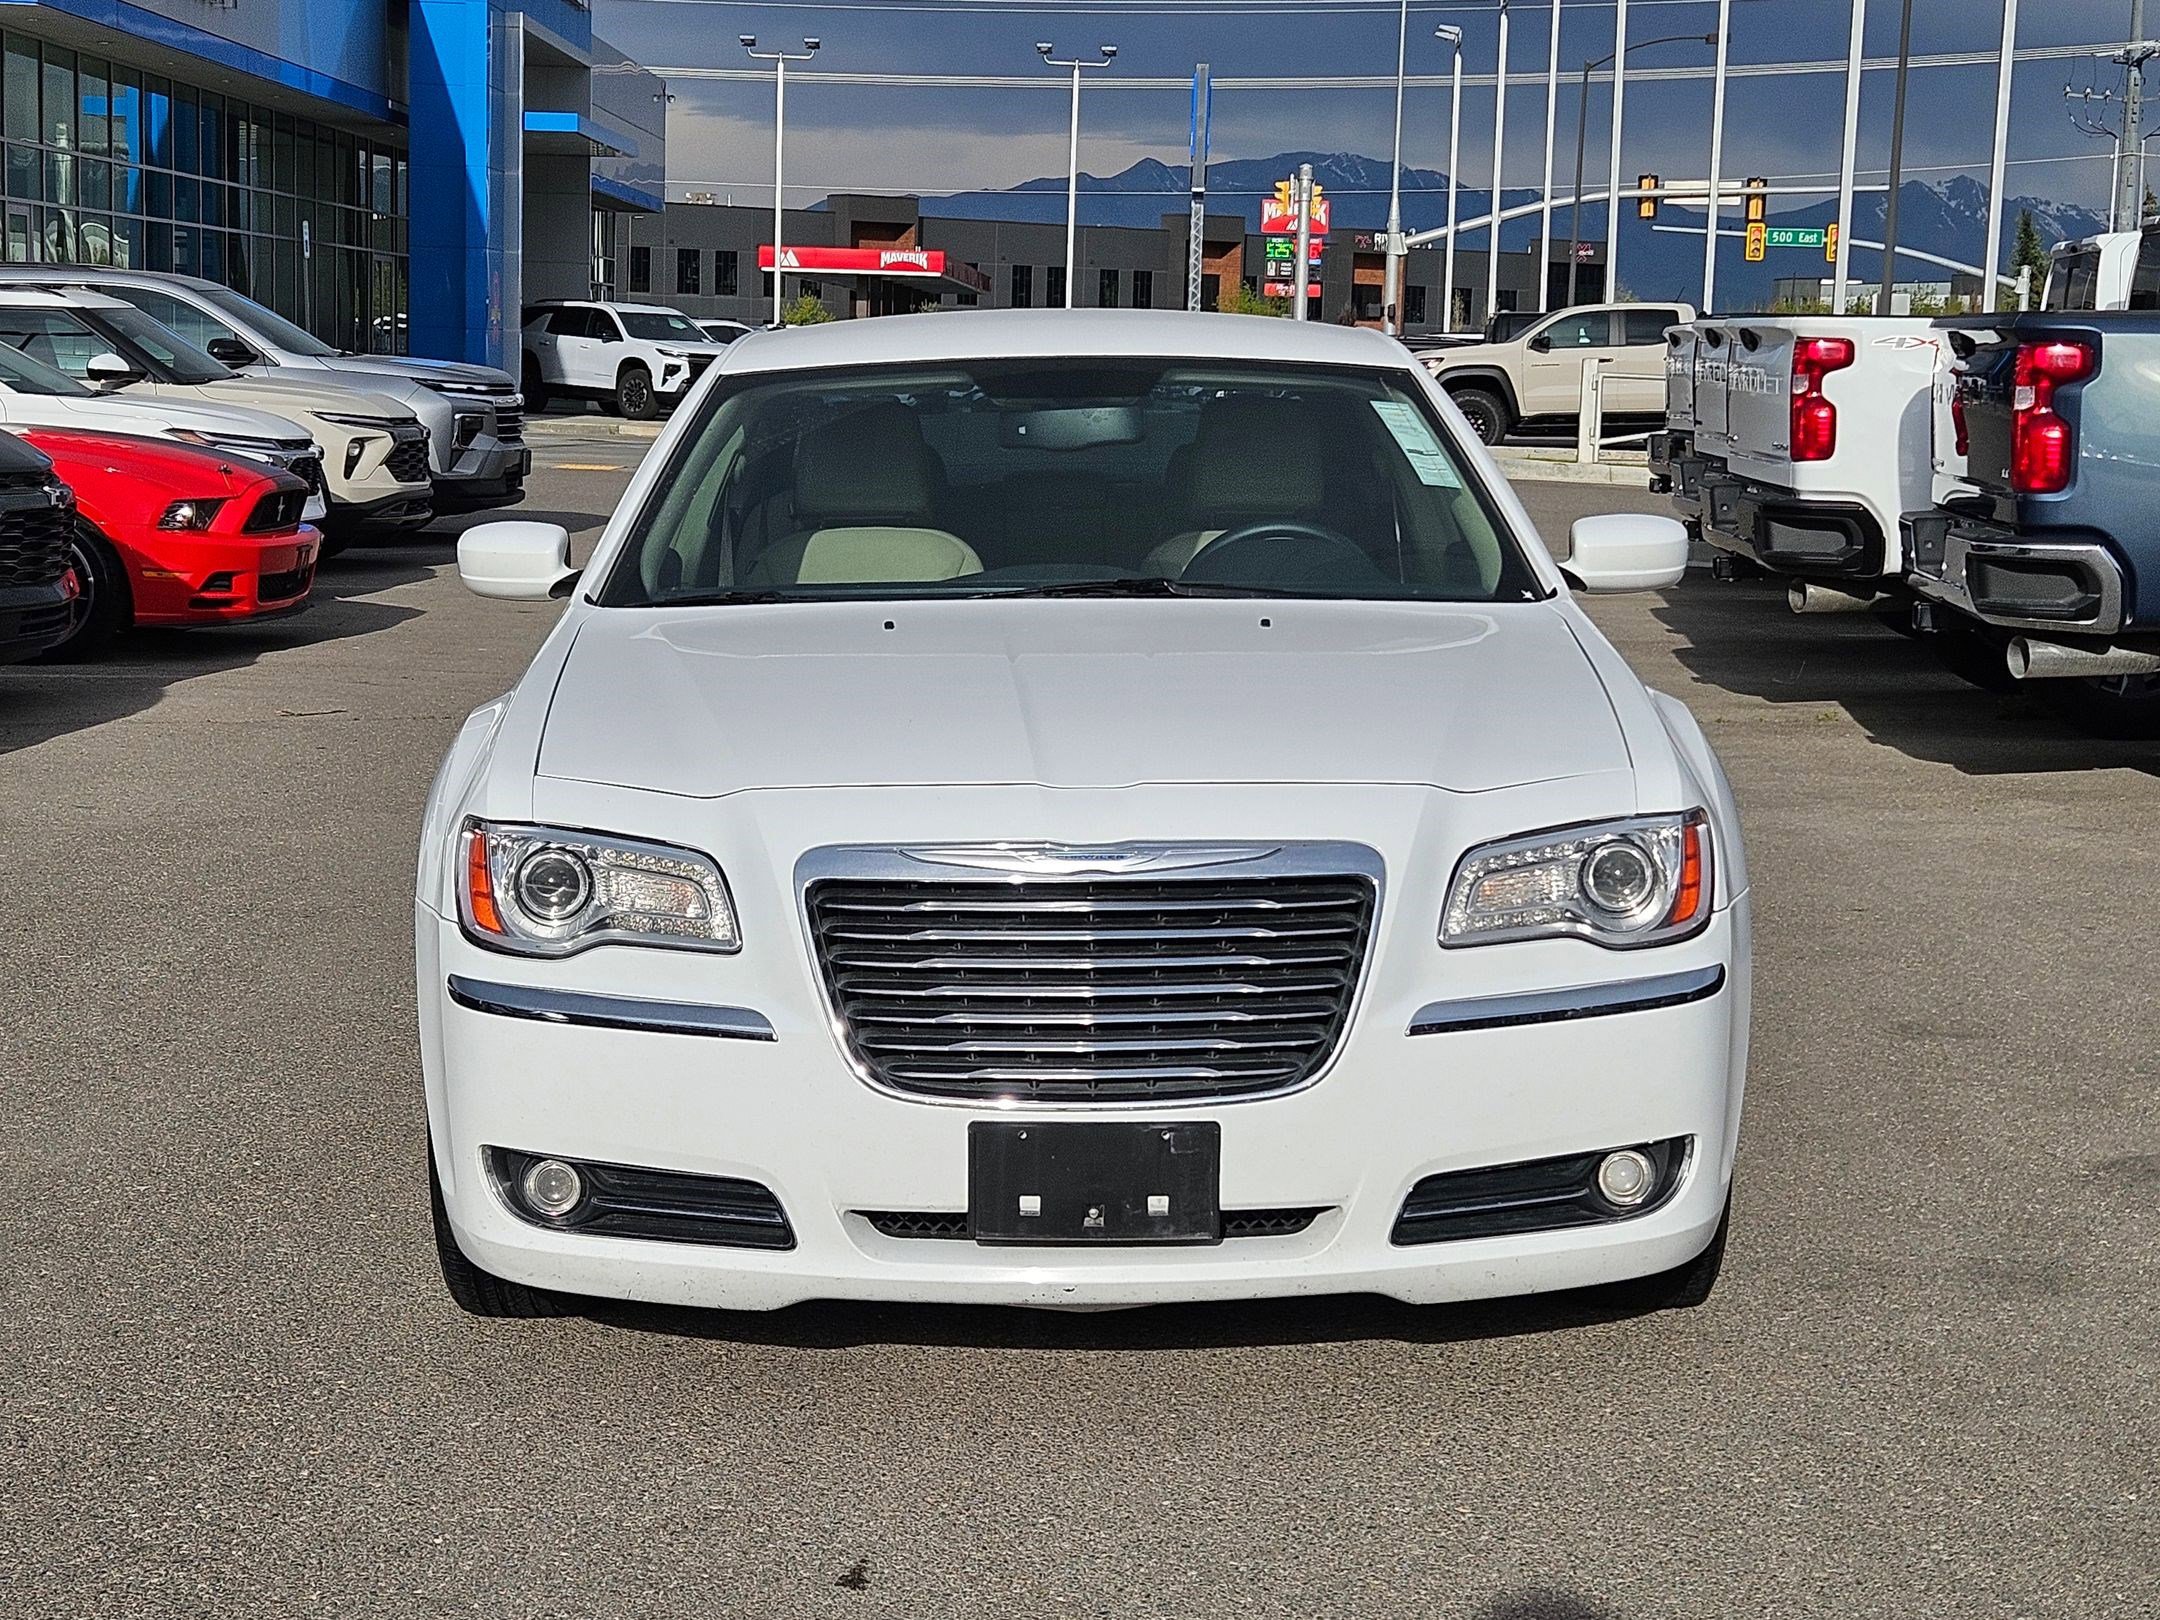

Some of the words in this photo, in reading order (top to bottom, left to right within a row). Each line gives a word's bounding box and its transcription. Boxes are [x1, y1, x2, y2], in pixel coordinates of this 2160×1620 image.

[1772, 231, 1793, 243] 500
[1798, 232, 1818, 244] East
[880, 251, 928, 271] MAVERIK
